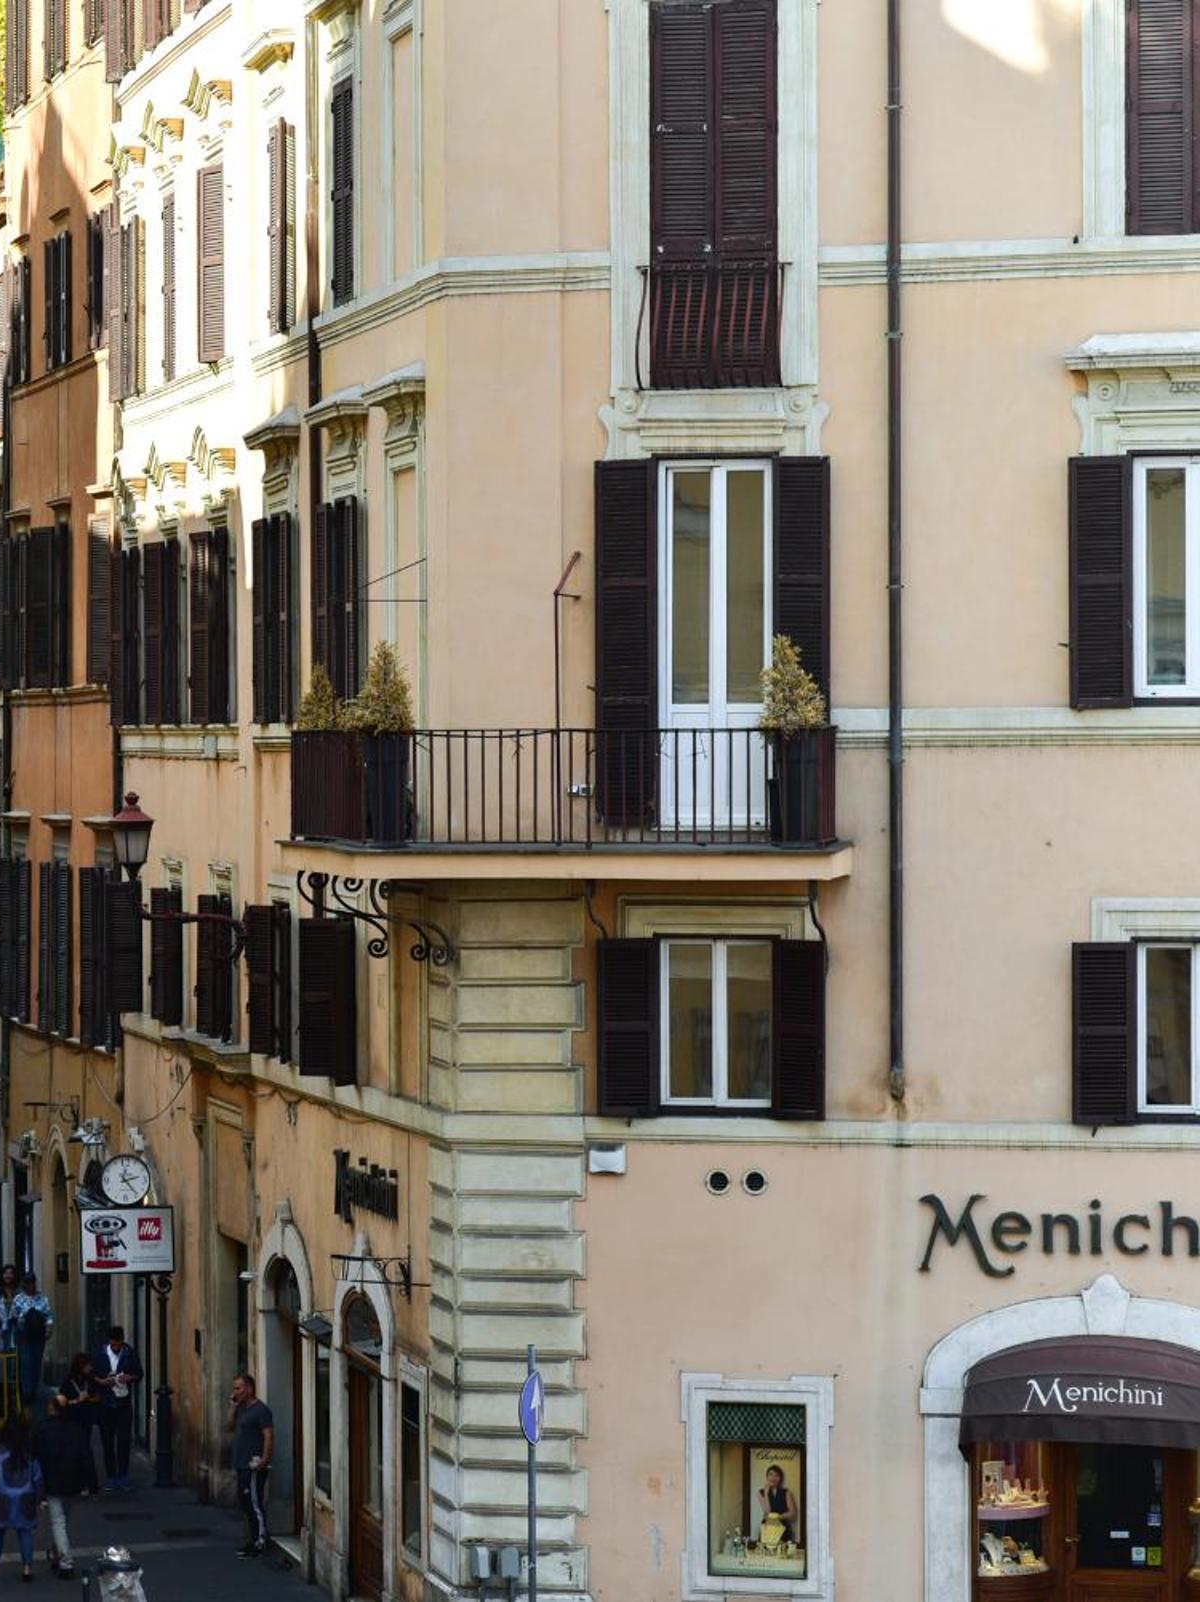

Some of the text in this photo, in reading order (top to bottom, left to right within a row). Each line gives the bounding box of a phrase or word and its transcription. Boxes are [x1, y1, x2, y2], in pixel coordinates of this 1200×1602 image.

[139, 1220, 160, 1238] illy
[918, 1193, 1200, 1278] Menich
[1022, 1378, 1164, 1413] Menichini
